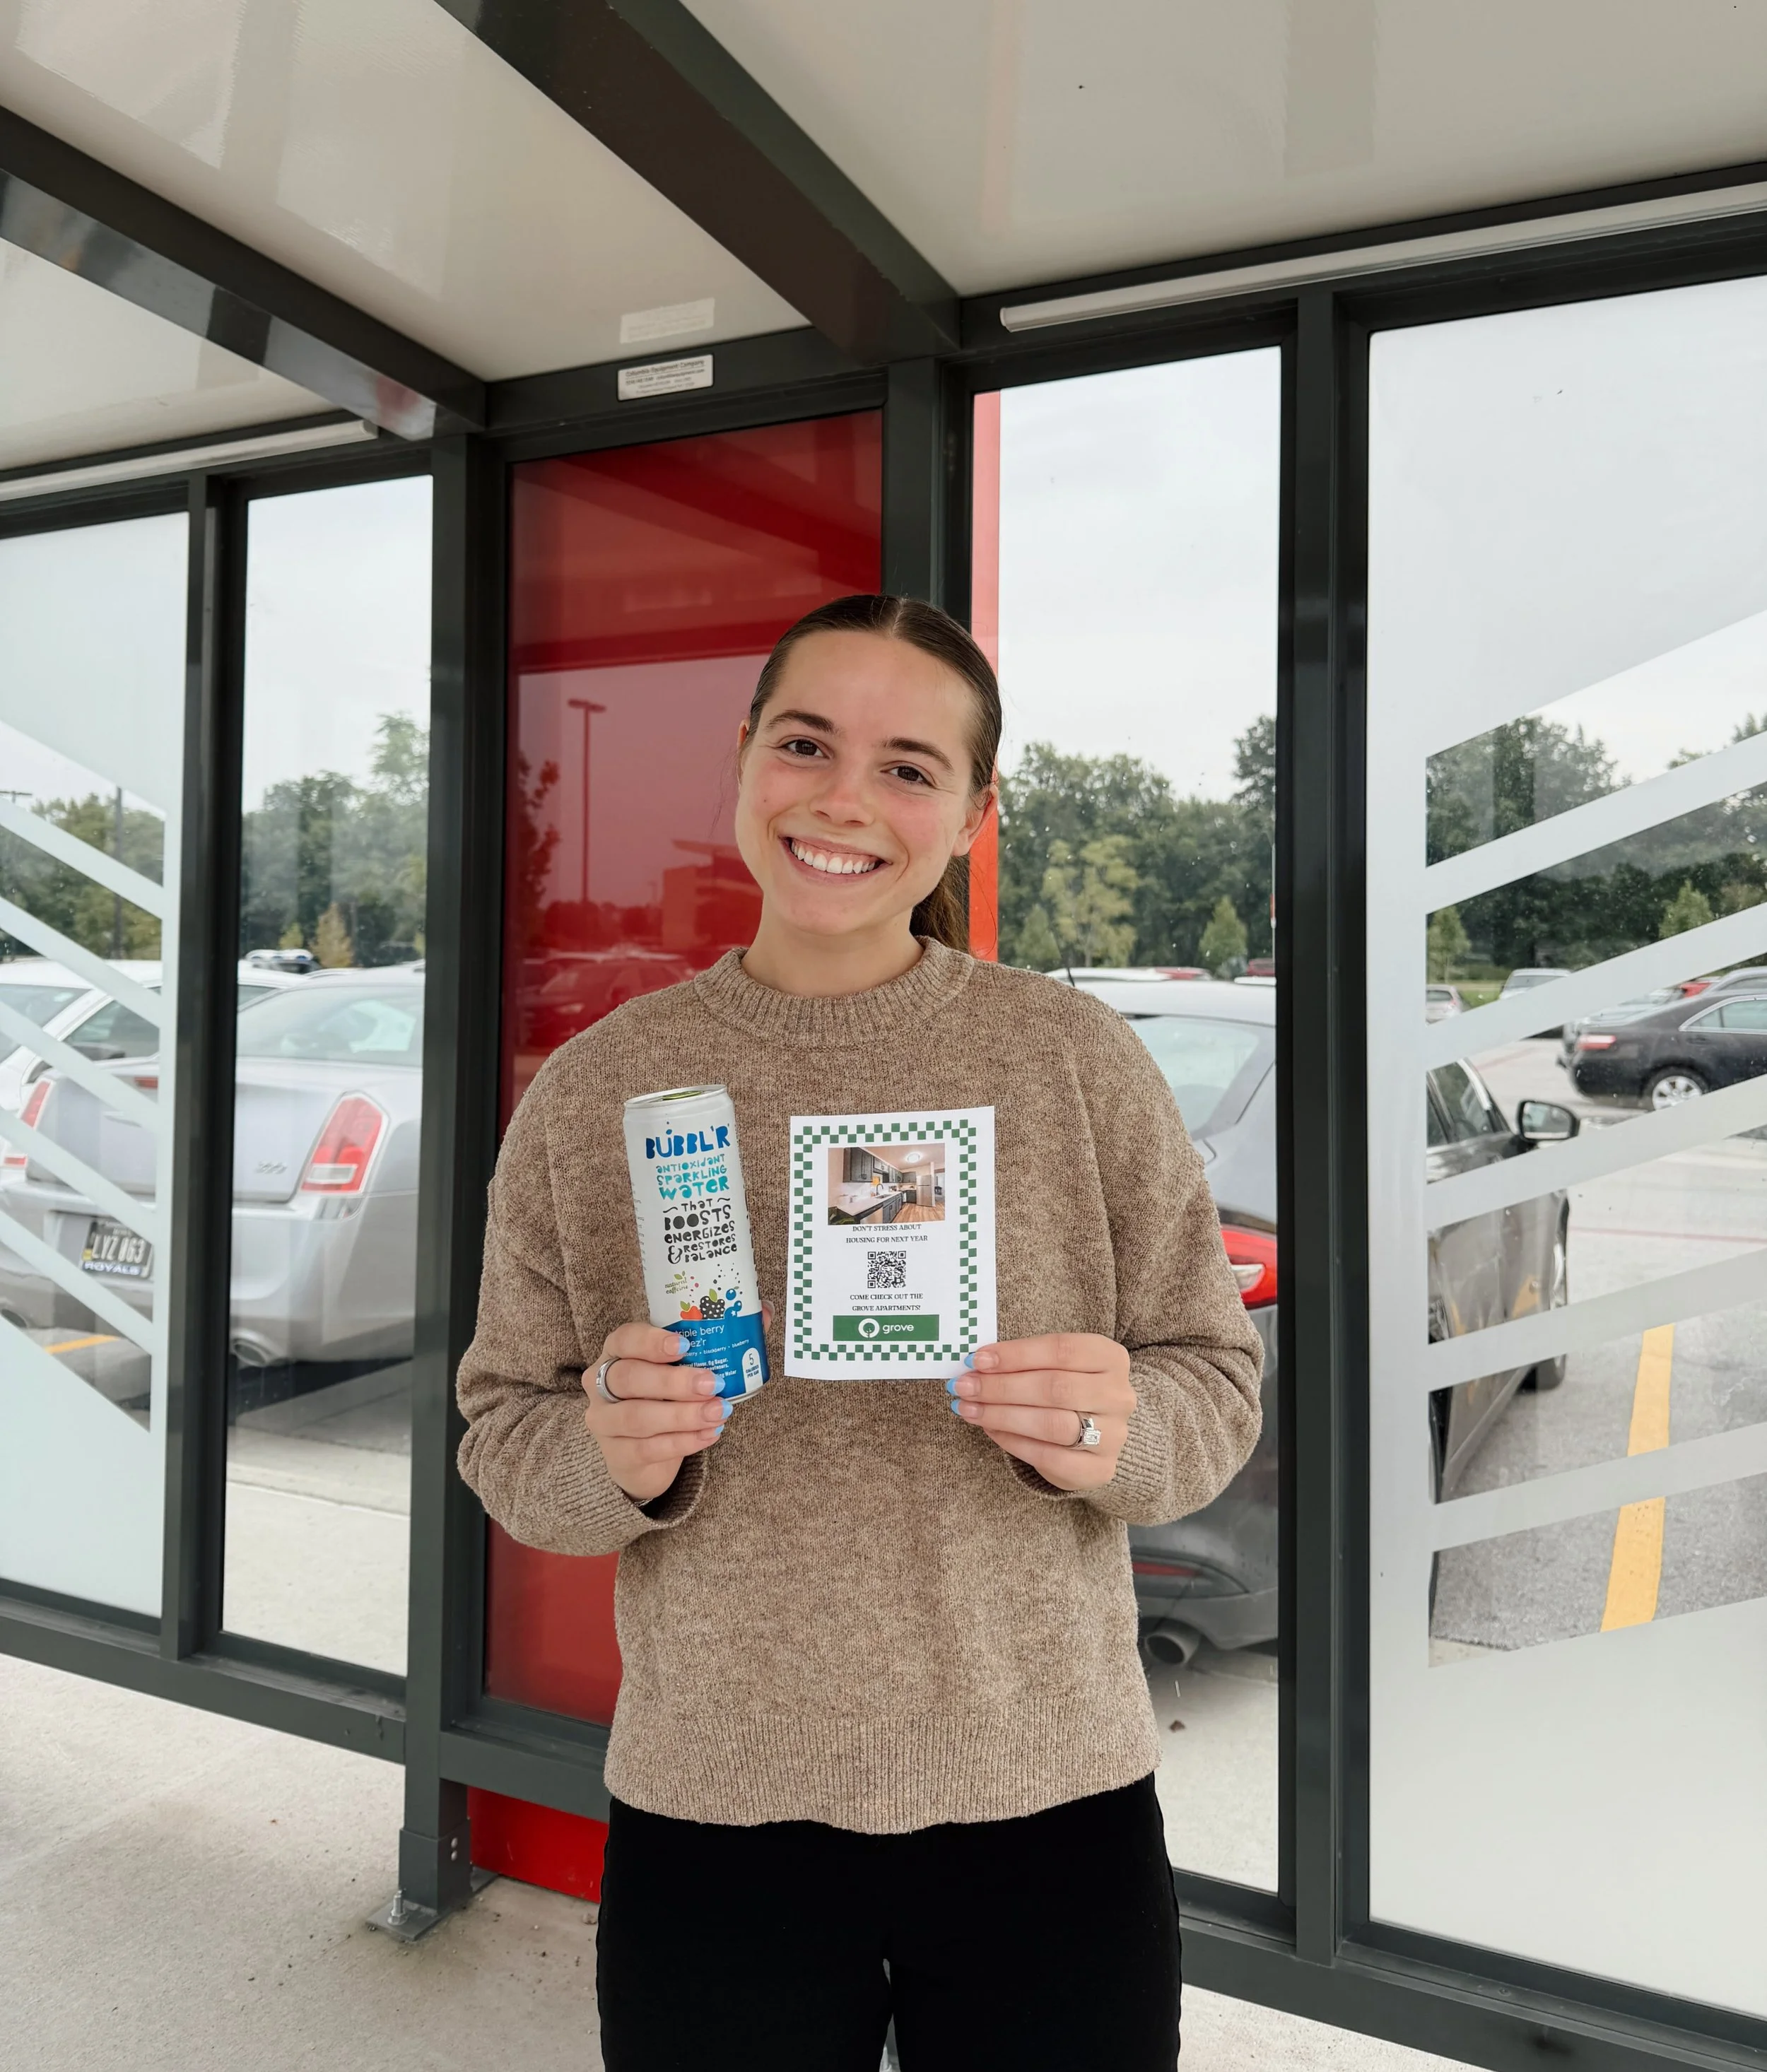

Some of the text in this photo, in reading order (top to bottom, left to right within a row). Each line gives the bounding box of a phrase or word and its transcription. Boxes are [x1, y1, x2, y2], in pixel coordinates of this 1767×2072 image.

[646, 1126, 730, 1159] BUBBL'R
[664, 1204, 732, 1230] BOOSTS
[665, 1277, 688, 1288] natural
[700, 1324, 724, 1336] berry
[882, 1324, 914, 1334] grove
[703, 1346, 727, 1355] blackberry
[732, 1339, 749, 1348] blueberry
[749, 1353, 754, 1365] 5
[746, 1365, 759, 1374] CALORIES
